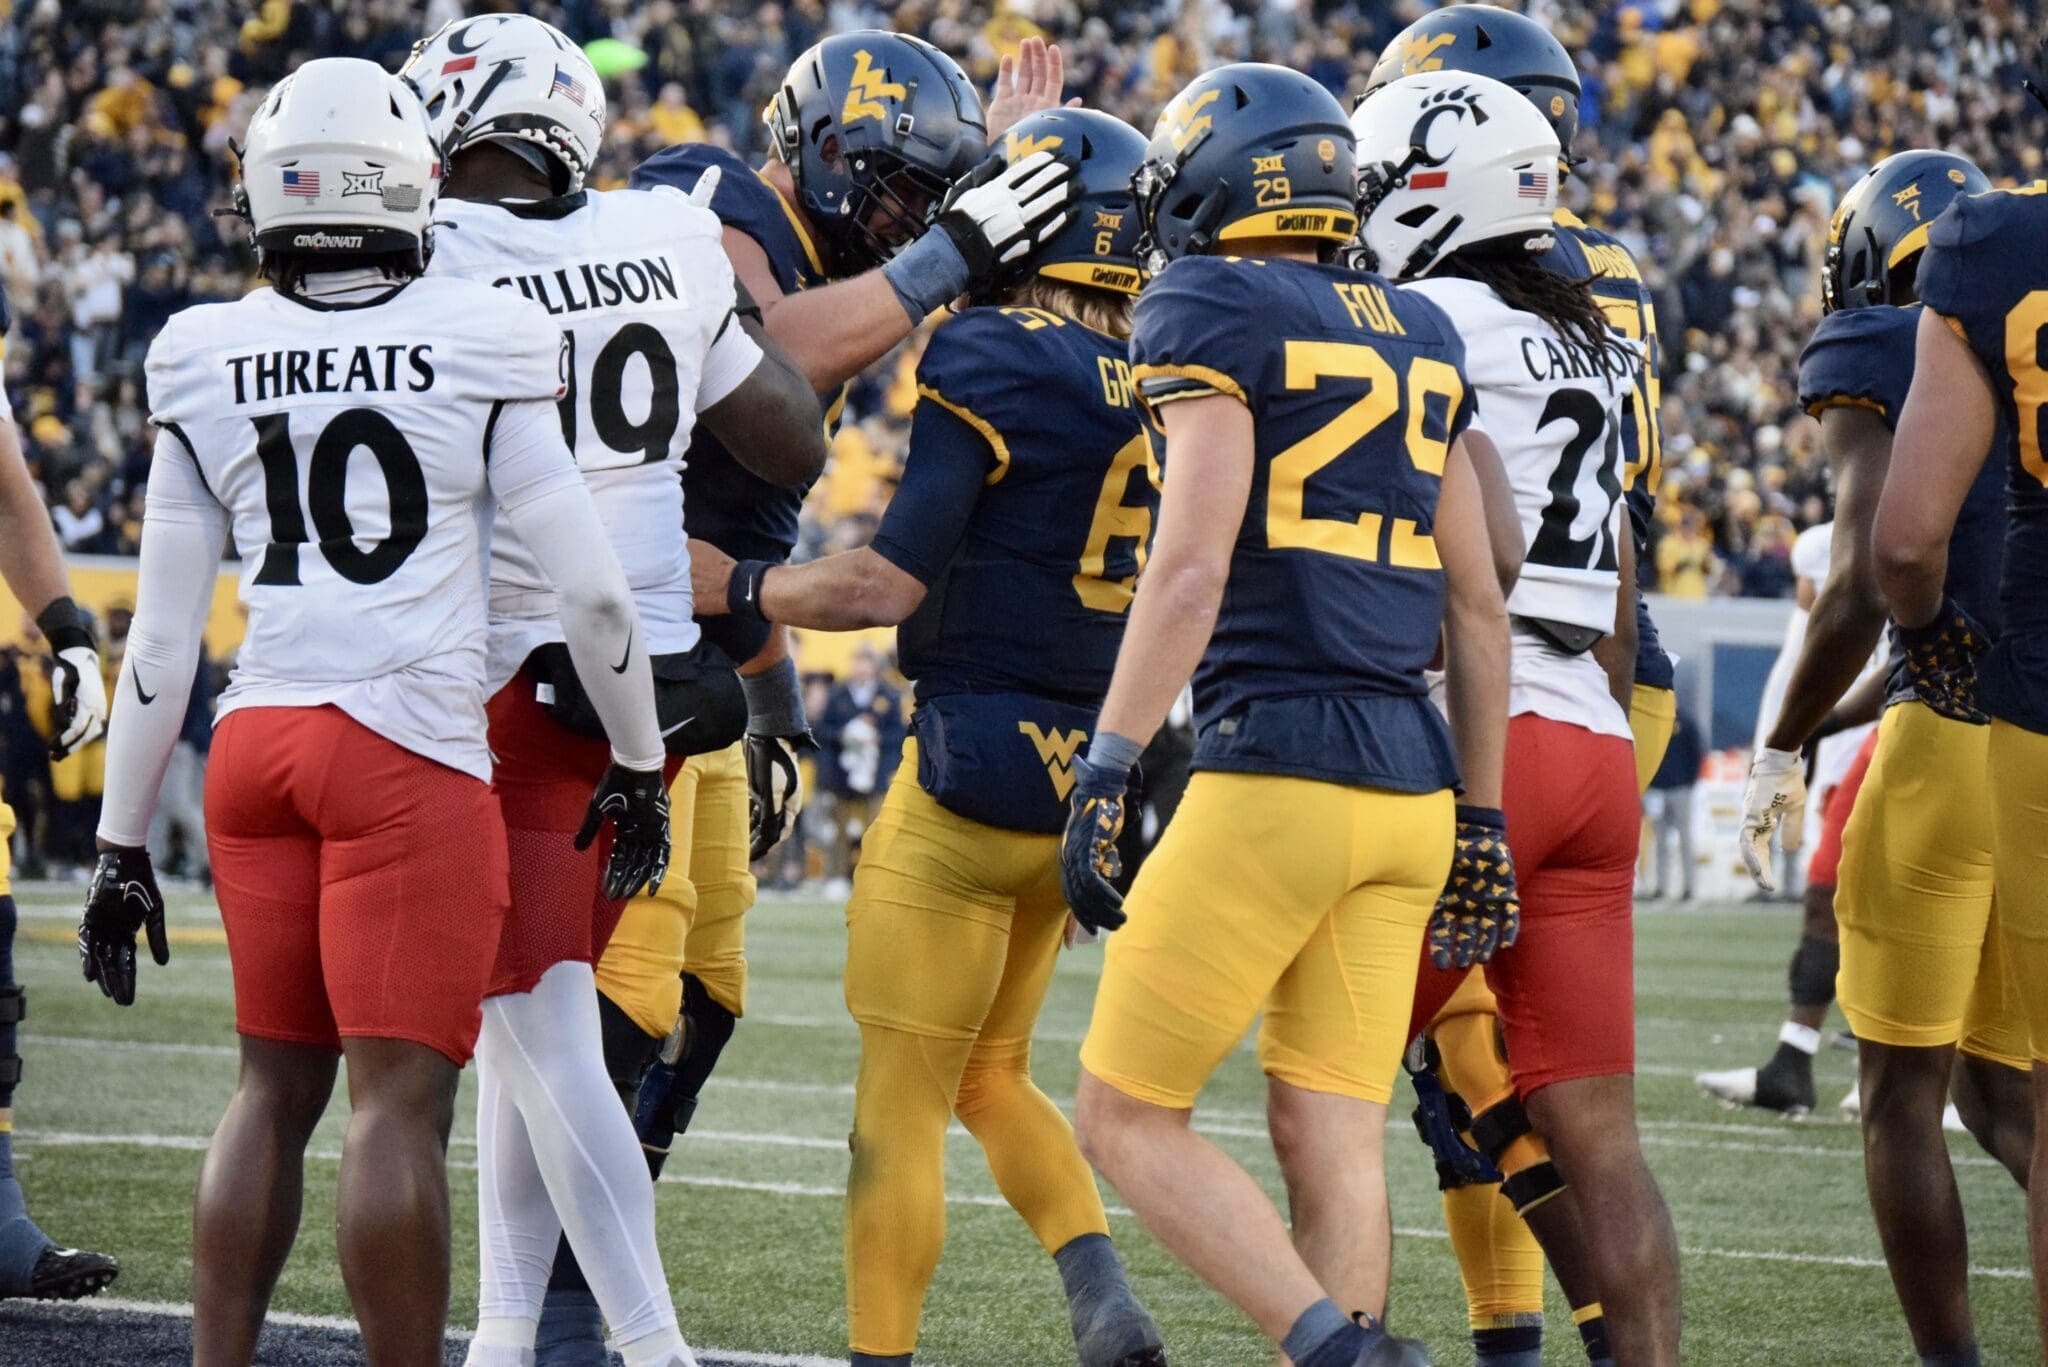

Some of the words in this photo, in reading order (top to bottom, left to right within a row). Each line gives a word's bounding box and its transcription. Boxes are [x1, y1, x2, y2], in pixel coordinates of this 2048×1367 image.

[1253, 176, 1291, 208] 29
[1903, 199, 1921, 221] 7
[293, 231, 363, 248] CINCINNATI
[1094, 231, 1113, 256] 6
[491, 256, 679, 315] ILLISON
[1332, 276, 1407, 336] FOX
[226, 344, 435, 404] THREATS
[1266, 340, 1464, 570] 29
[249, 408, 429, 586] 10
[1072, 424, 1154, 614] 6
